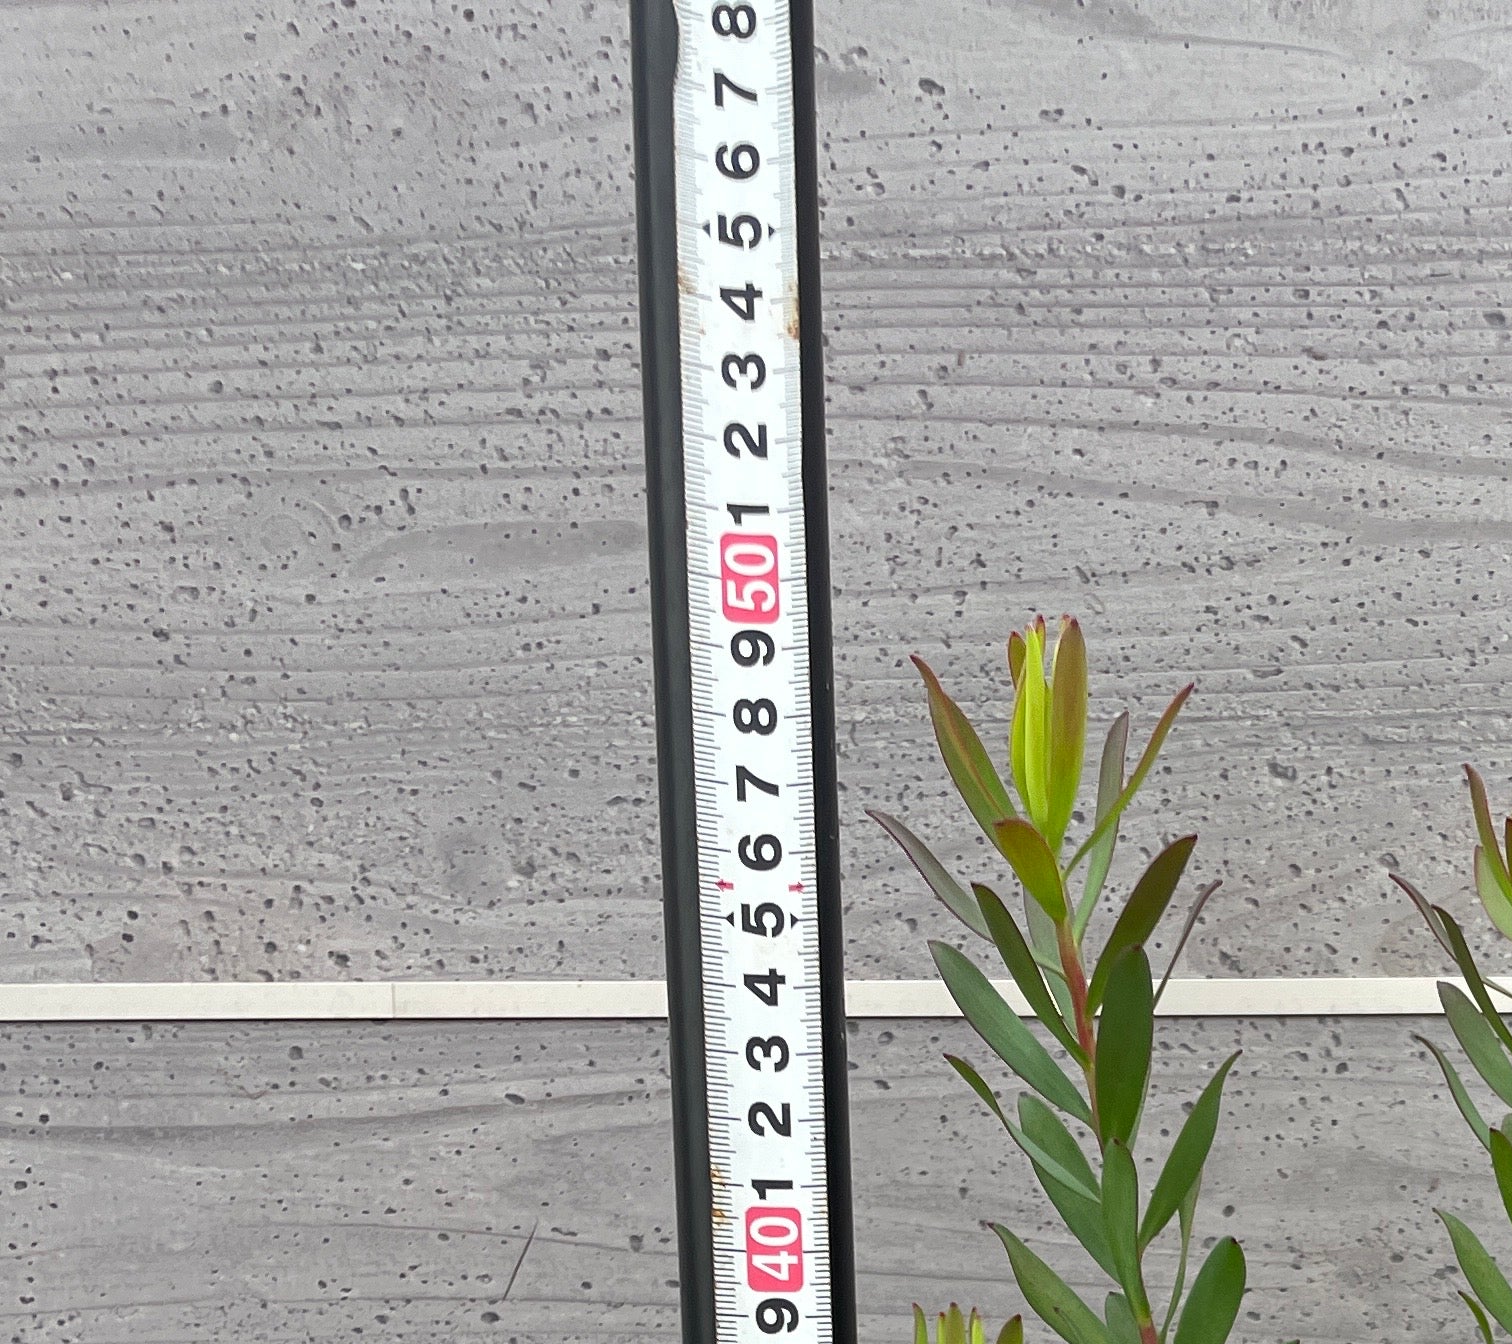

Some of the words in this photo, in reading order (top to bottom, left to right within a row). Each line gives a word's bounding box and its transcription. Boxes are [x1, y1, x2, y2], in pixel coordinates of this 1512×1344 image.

[711, 4, 757, 39] 8
[713, 72, 758, 107] 7
[715, 143, 760, 180] 6
[717, 214, 762, 249] 5
[719, 283, 763, 321] 4
[721, 353, 767, 390] 3
[723, 422, 768, 459] 2
[726, 503, 770, 525] 1
[724, 544, 776, 611] 50
[730, 629, 776, 667] 9
[732, 697, 778, 736] 8
[735, 765, 780, 803] 7
[737, 833, 783, 872] 6
[740, 902, 785, 938] 5
[743, 968, 786, 1007] 4
[745, 1035, 790, 1073] 3
[747, 1101, 792, 1138] 2
[751, 1179, 794, 1201] 1
[750, 1217, 798, 1280] 40
[755, 1297, 799, 1335] 9
